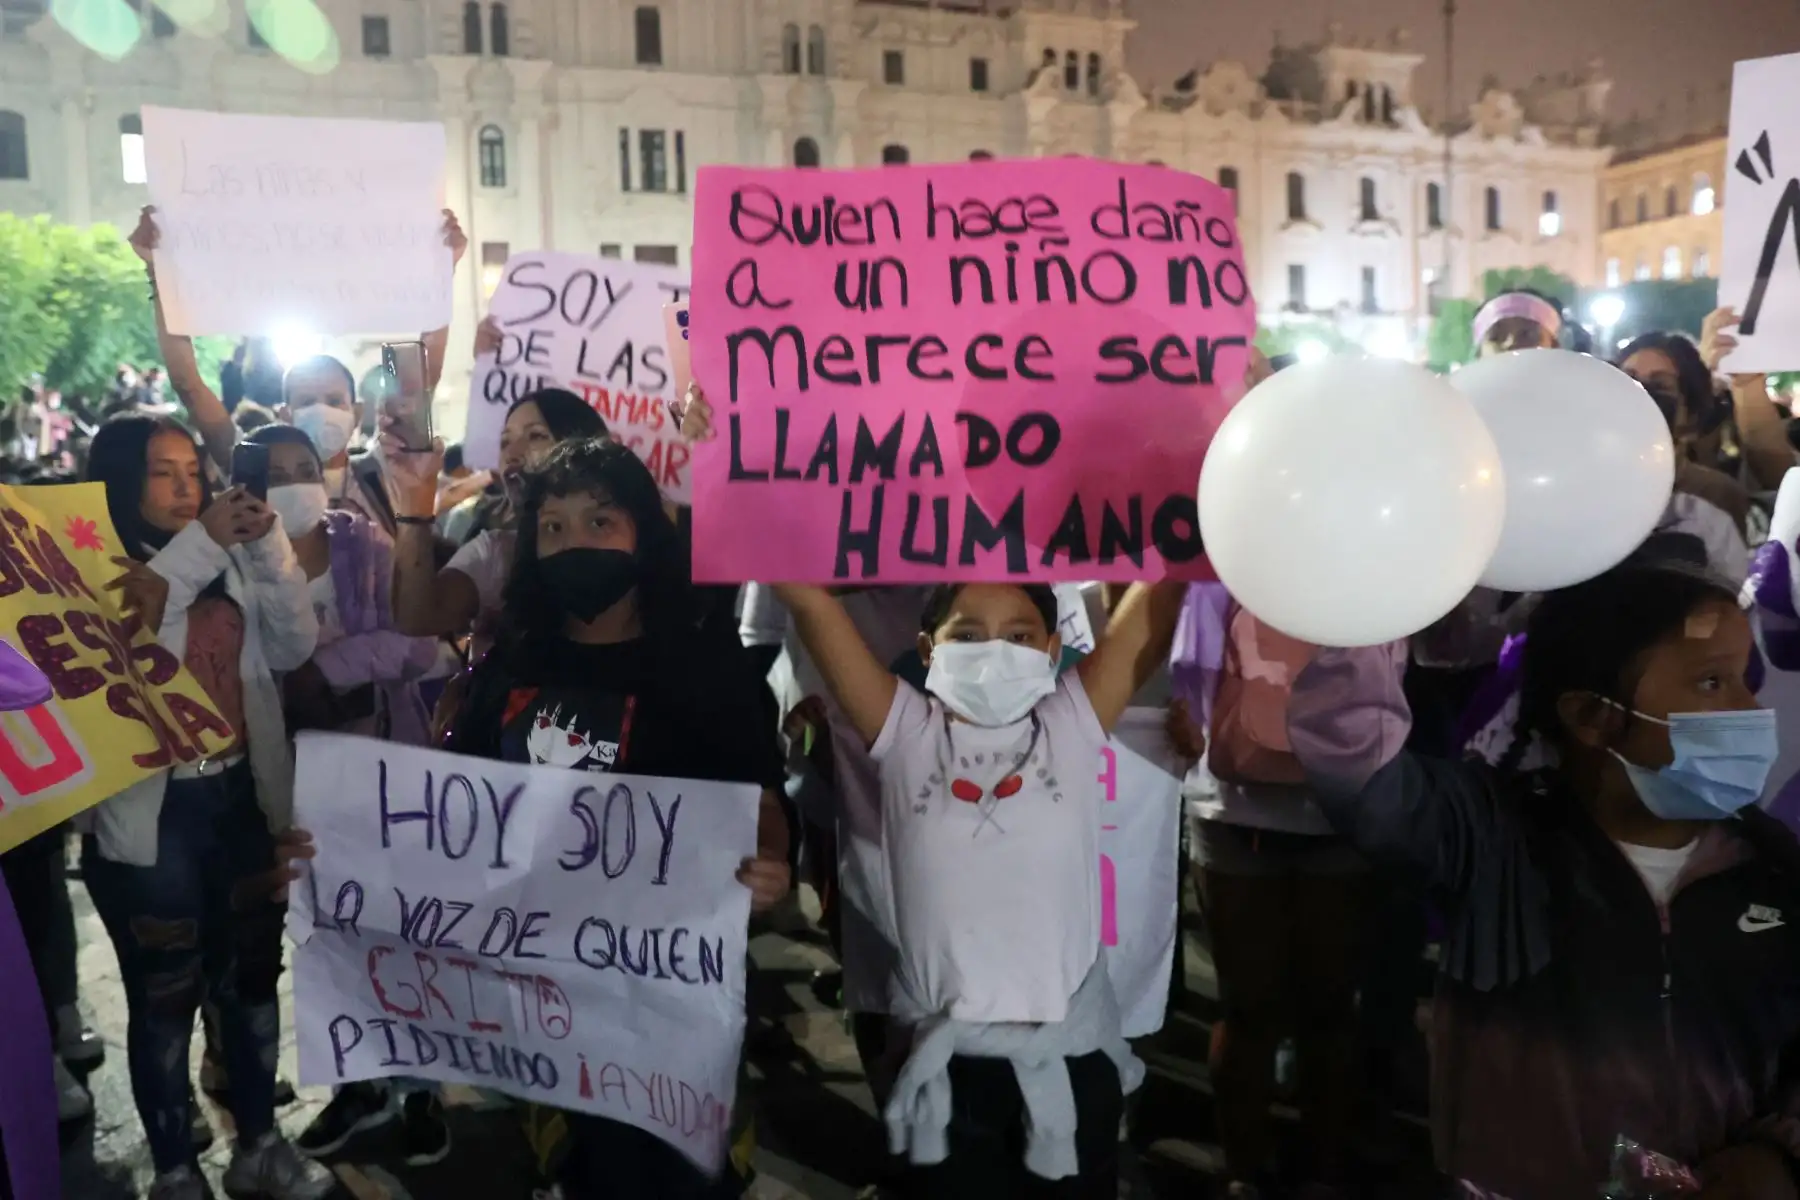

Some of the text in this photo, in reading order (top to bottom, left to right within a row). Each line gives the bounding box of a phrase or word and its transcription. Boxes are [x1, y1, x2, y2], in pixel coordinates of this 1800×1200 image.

[728, 177, 1234, 248] Quien hace daño
[503, 261, 633, 333] SOY
[725, 237, 1248, 313] a un niño no
[494, 330, 667, 393] DE LAS
[1095, 334, 1247, 386] ser
[728, 407, 1062, 486] LLAMADO
[834, 484, 1204, 578] HUMANO
[378, 758, 682, 885] HOY SOY
[304, 861, 724, 985] LA VOZ DE QUIEN
[366, 946, 572, 1039] GRITO
[327, 1014, 559, 1090] PIDIENDO
